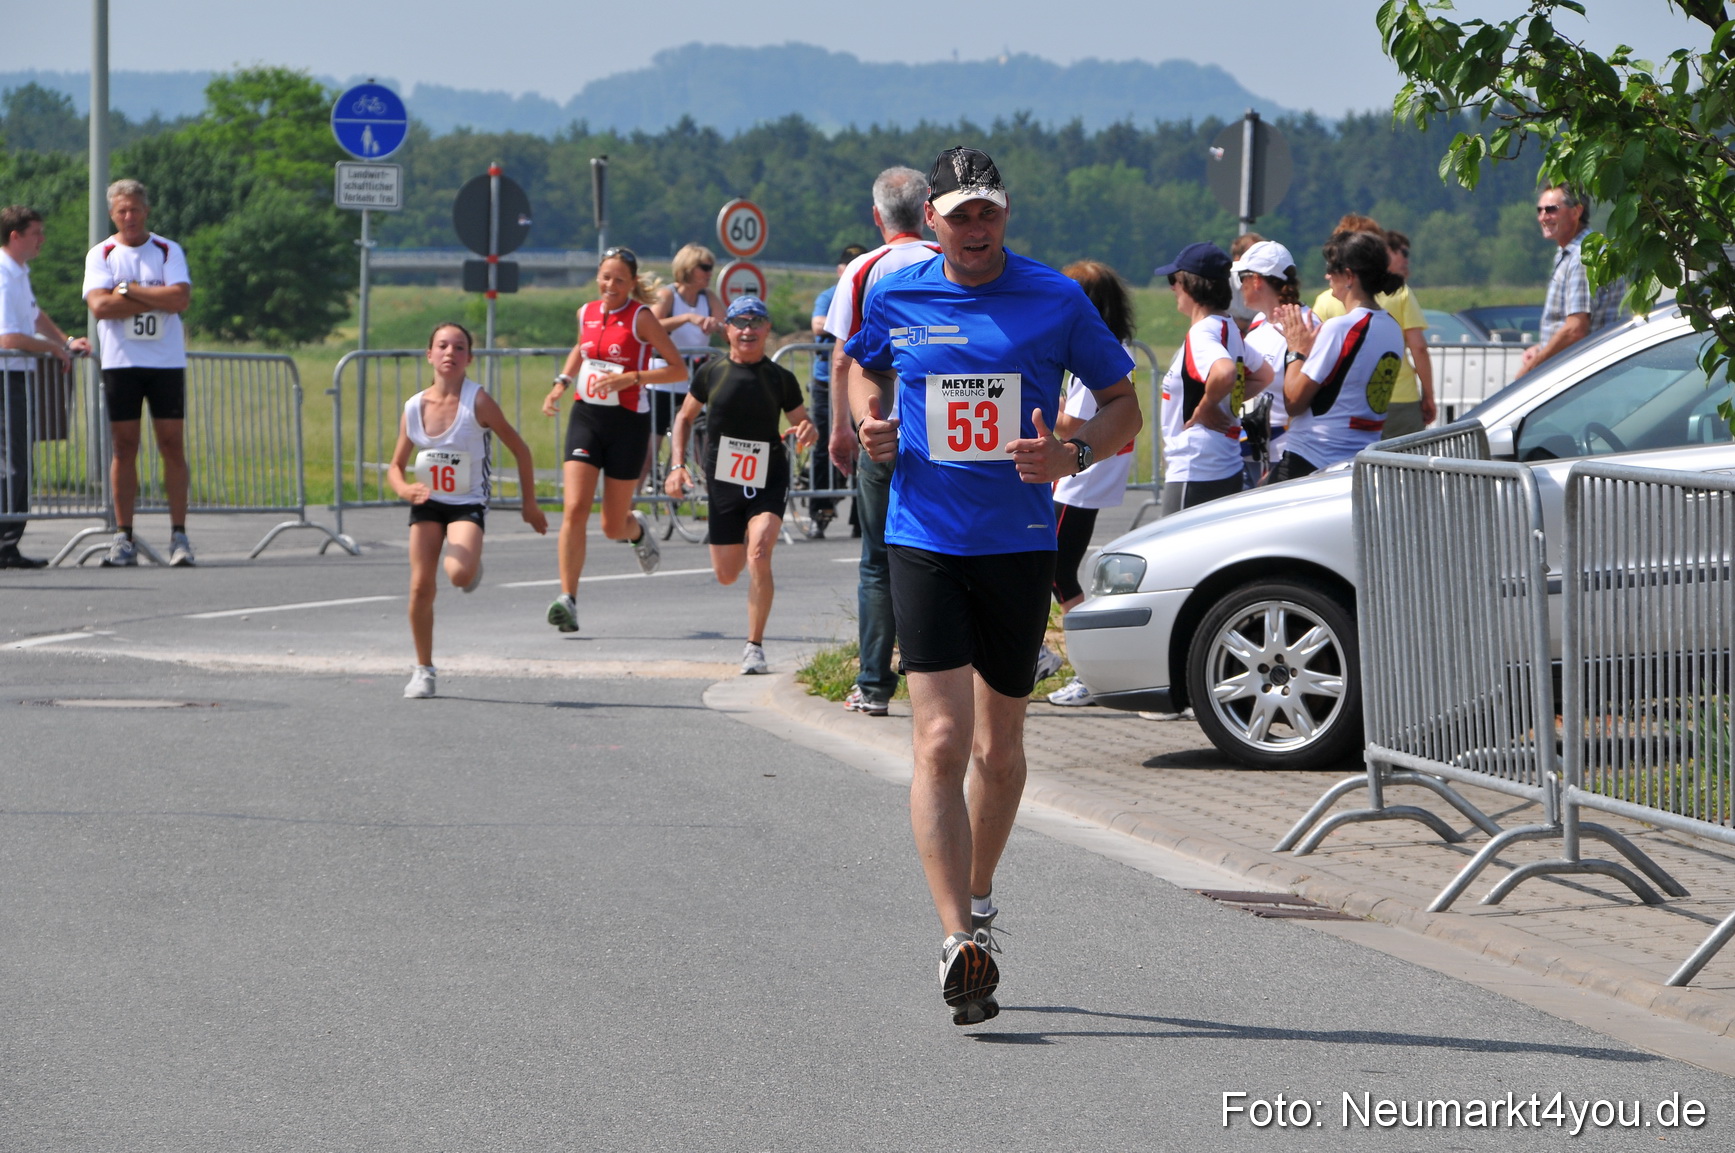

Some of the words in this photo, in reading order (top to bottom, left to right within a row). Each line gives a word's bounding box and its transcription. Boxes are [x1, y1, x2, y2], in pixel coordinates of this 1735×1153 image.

[347, 168, 390, 179] Landwirt-
[344, 181, 394, 191] schaftlicher
[344, 192, 375, 203] Verkehr
[731, 216, 757, 241] 60
[134, 314, 156, 336] 50
[941, 379, 985, 389] MEYER
[941, 389, 985, 397] WERBUNG
[947, 400, 999, 452] 53
[730, 453, 757, 481] 70
[429, 464, 455, 493] 16
